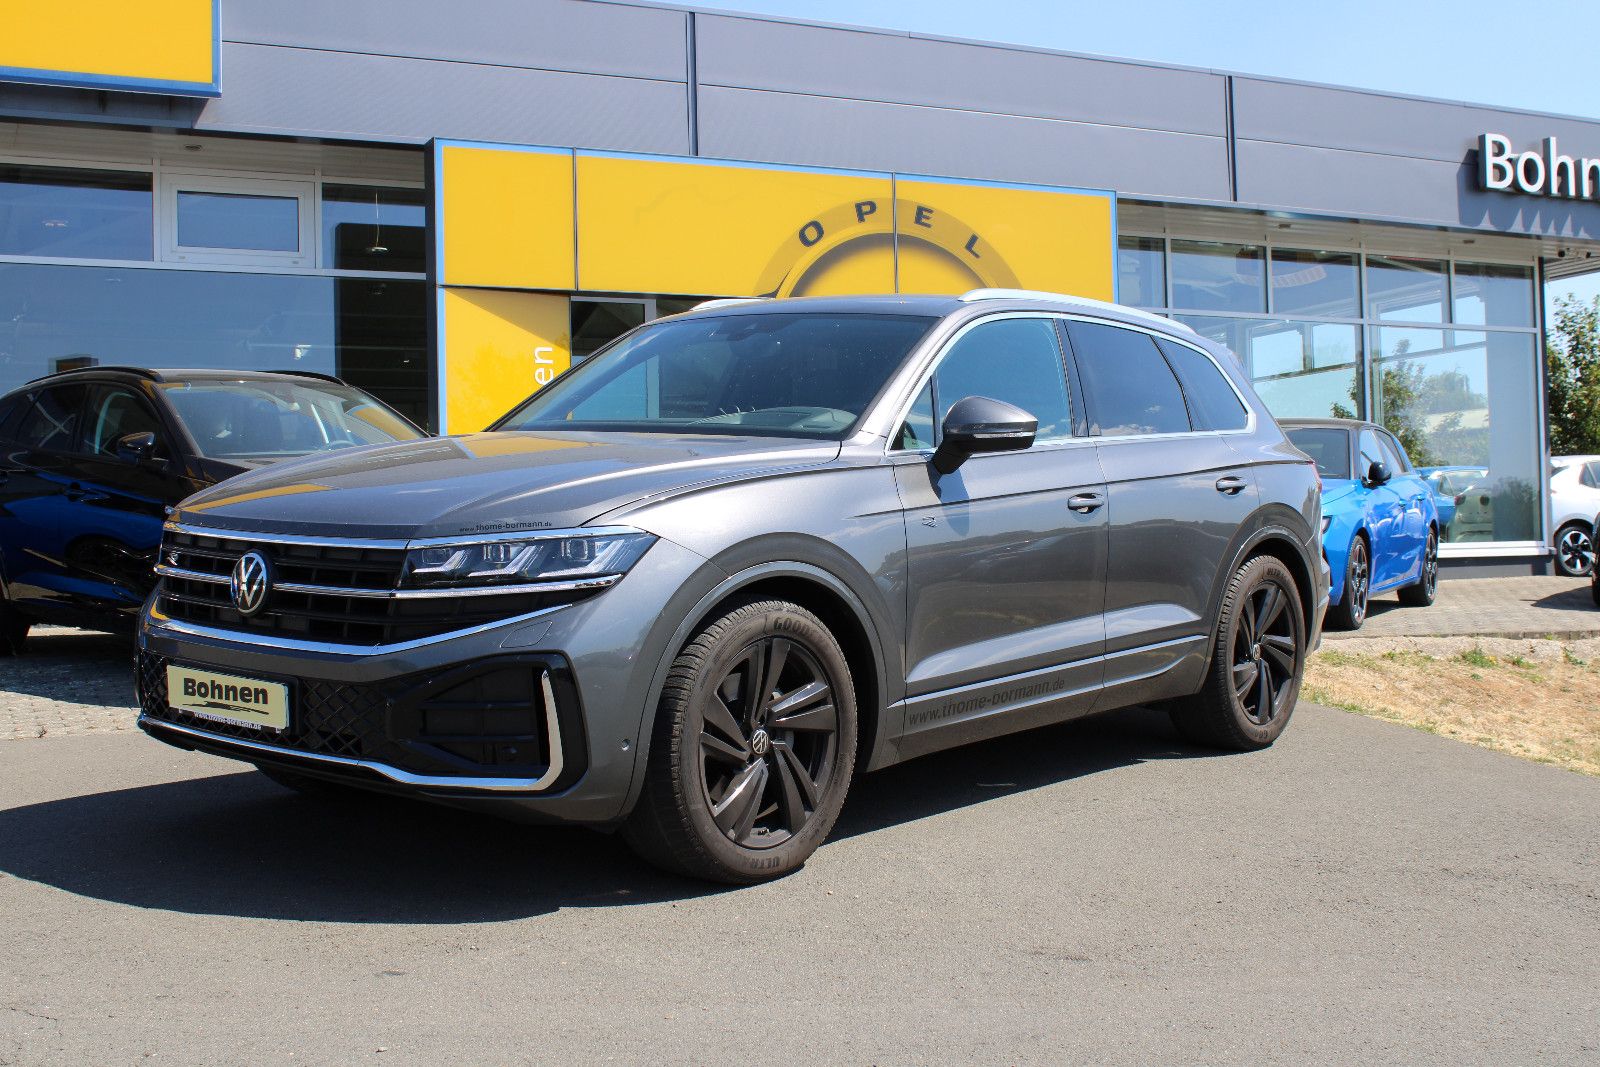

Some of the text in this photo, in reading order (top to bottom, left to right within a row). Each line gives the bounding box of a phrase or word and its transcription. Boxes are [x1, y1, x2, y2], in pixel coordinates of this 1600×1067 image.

[798, 200, 981, 259] OPEL
[183, 677, 269, 705] Bohnen
[909, 677, 1065, 725] www.thome-bormann.de
